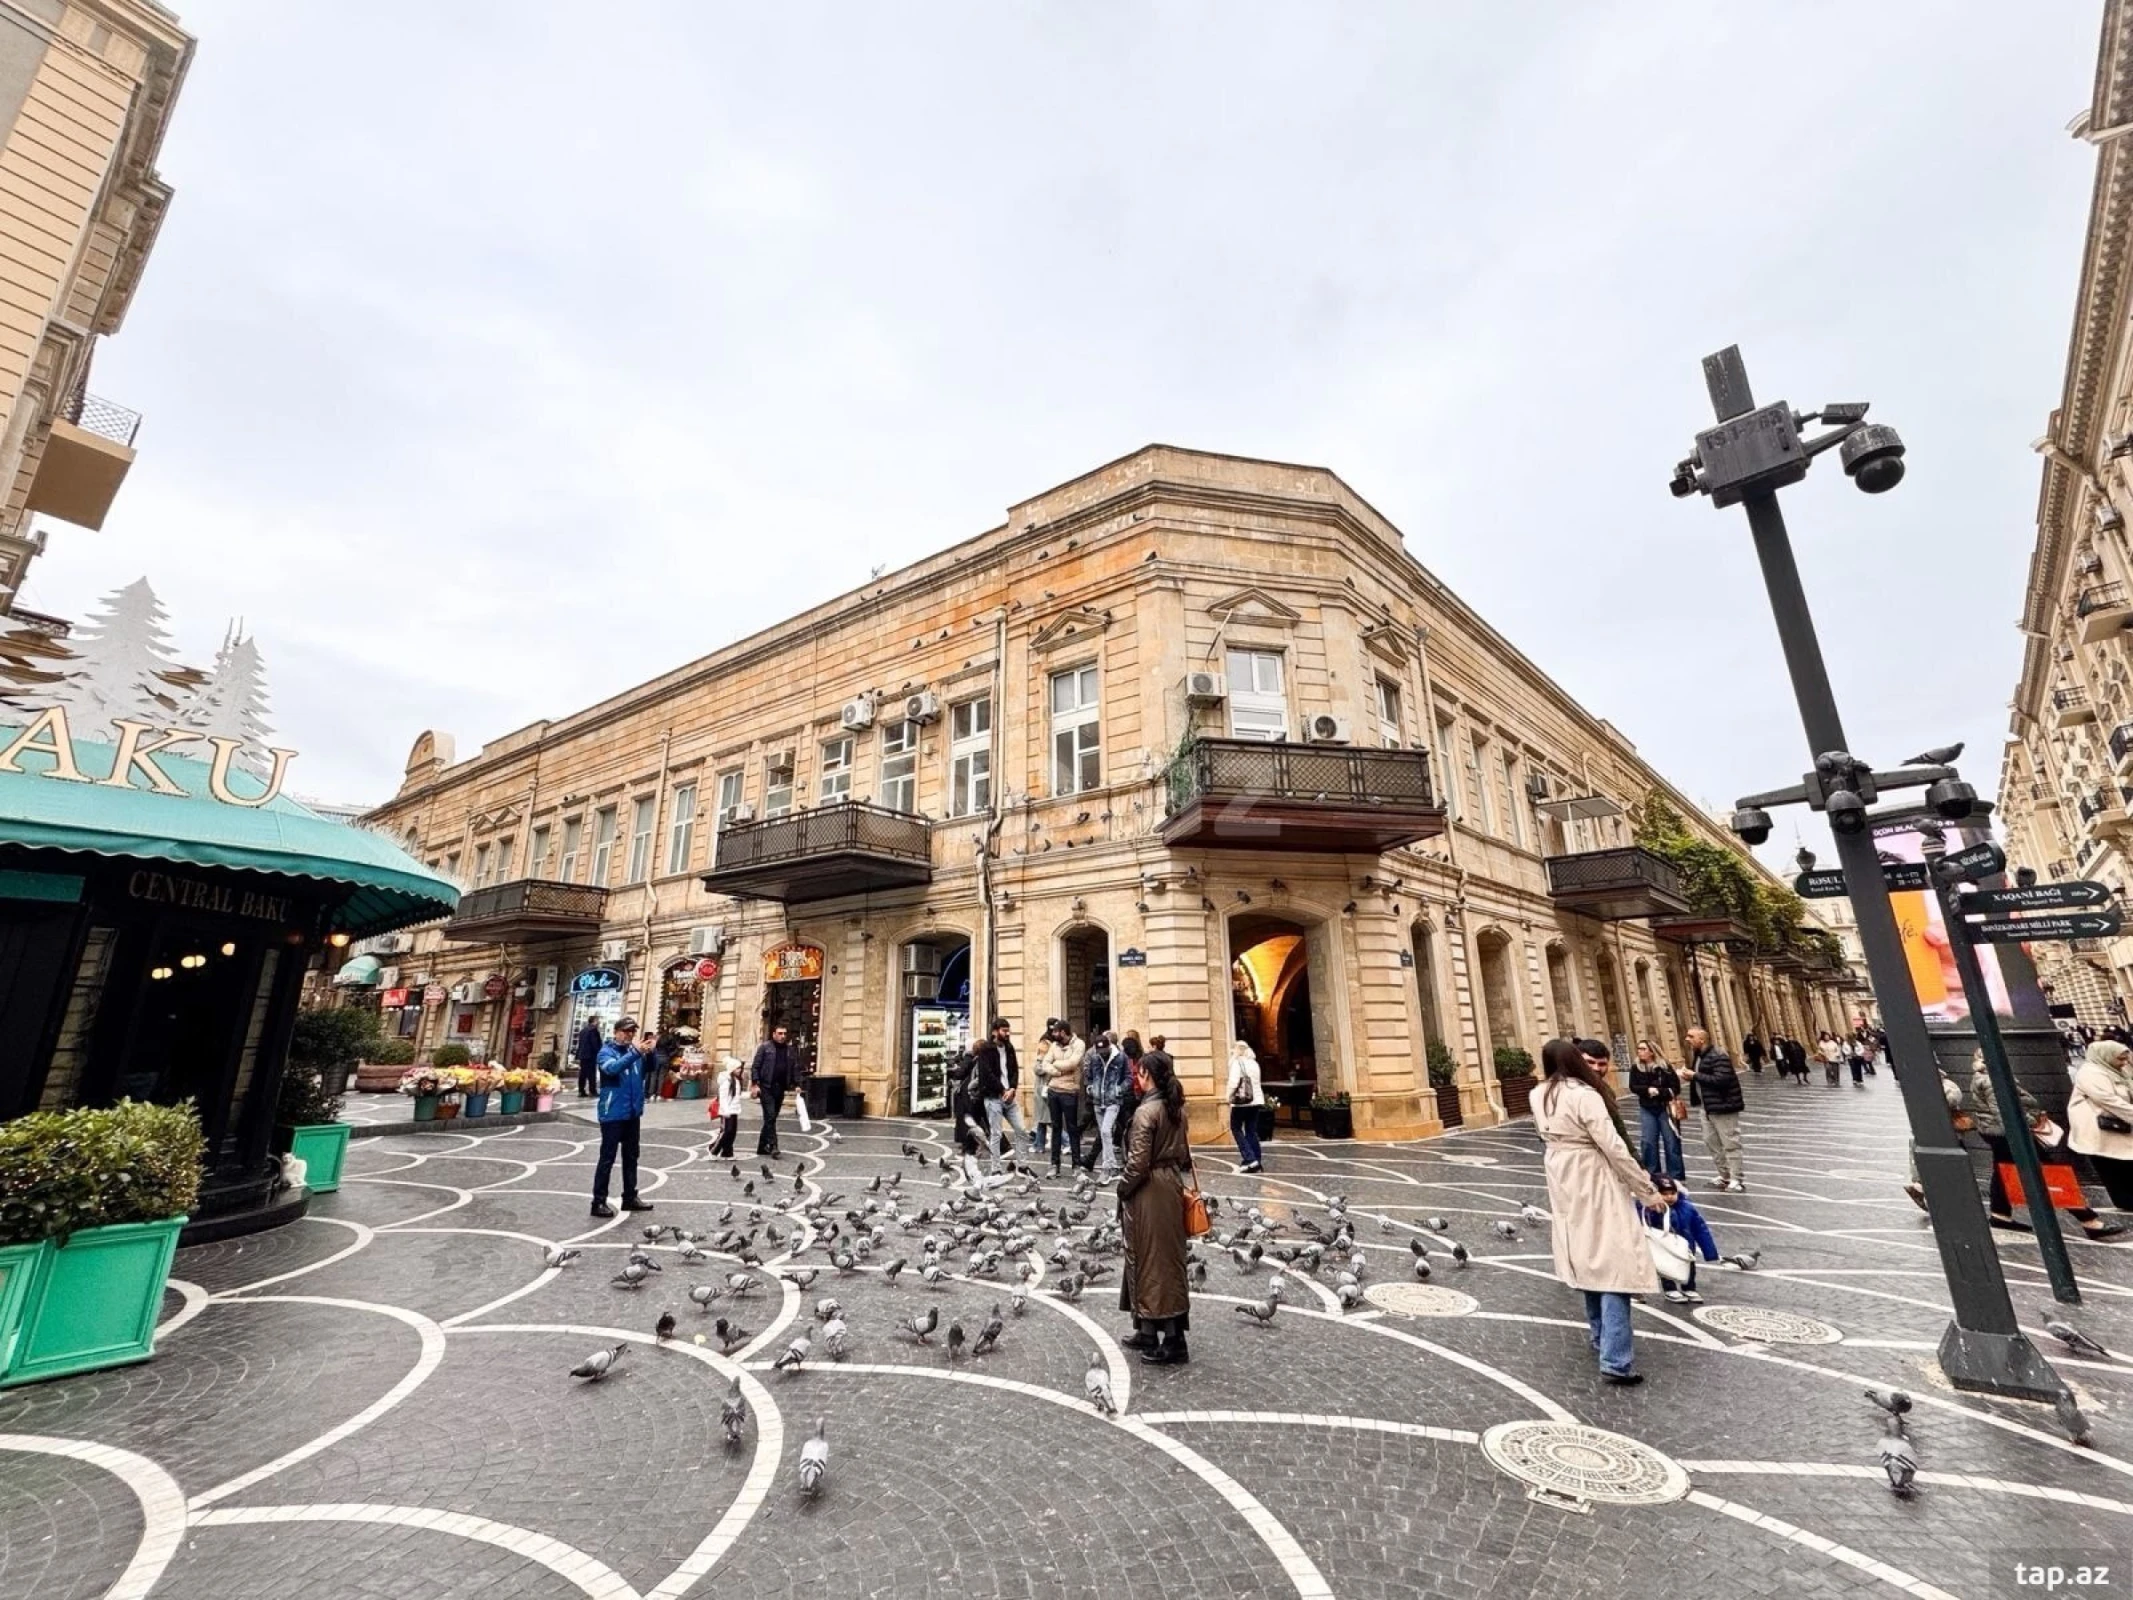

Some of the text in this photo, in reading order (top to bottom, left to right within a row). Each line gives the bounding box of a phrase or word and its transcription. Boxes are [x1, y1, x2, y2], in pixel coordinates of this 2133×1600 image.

[0, 704, 299, 809] AKU
[128, 869, 292, 923] CENTRAL BAKU
[1993, 889, 2034, 901] XAQANİ
[2051, 919, 2073, 928] PARK
